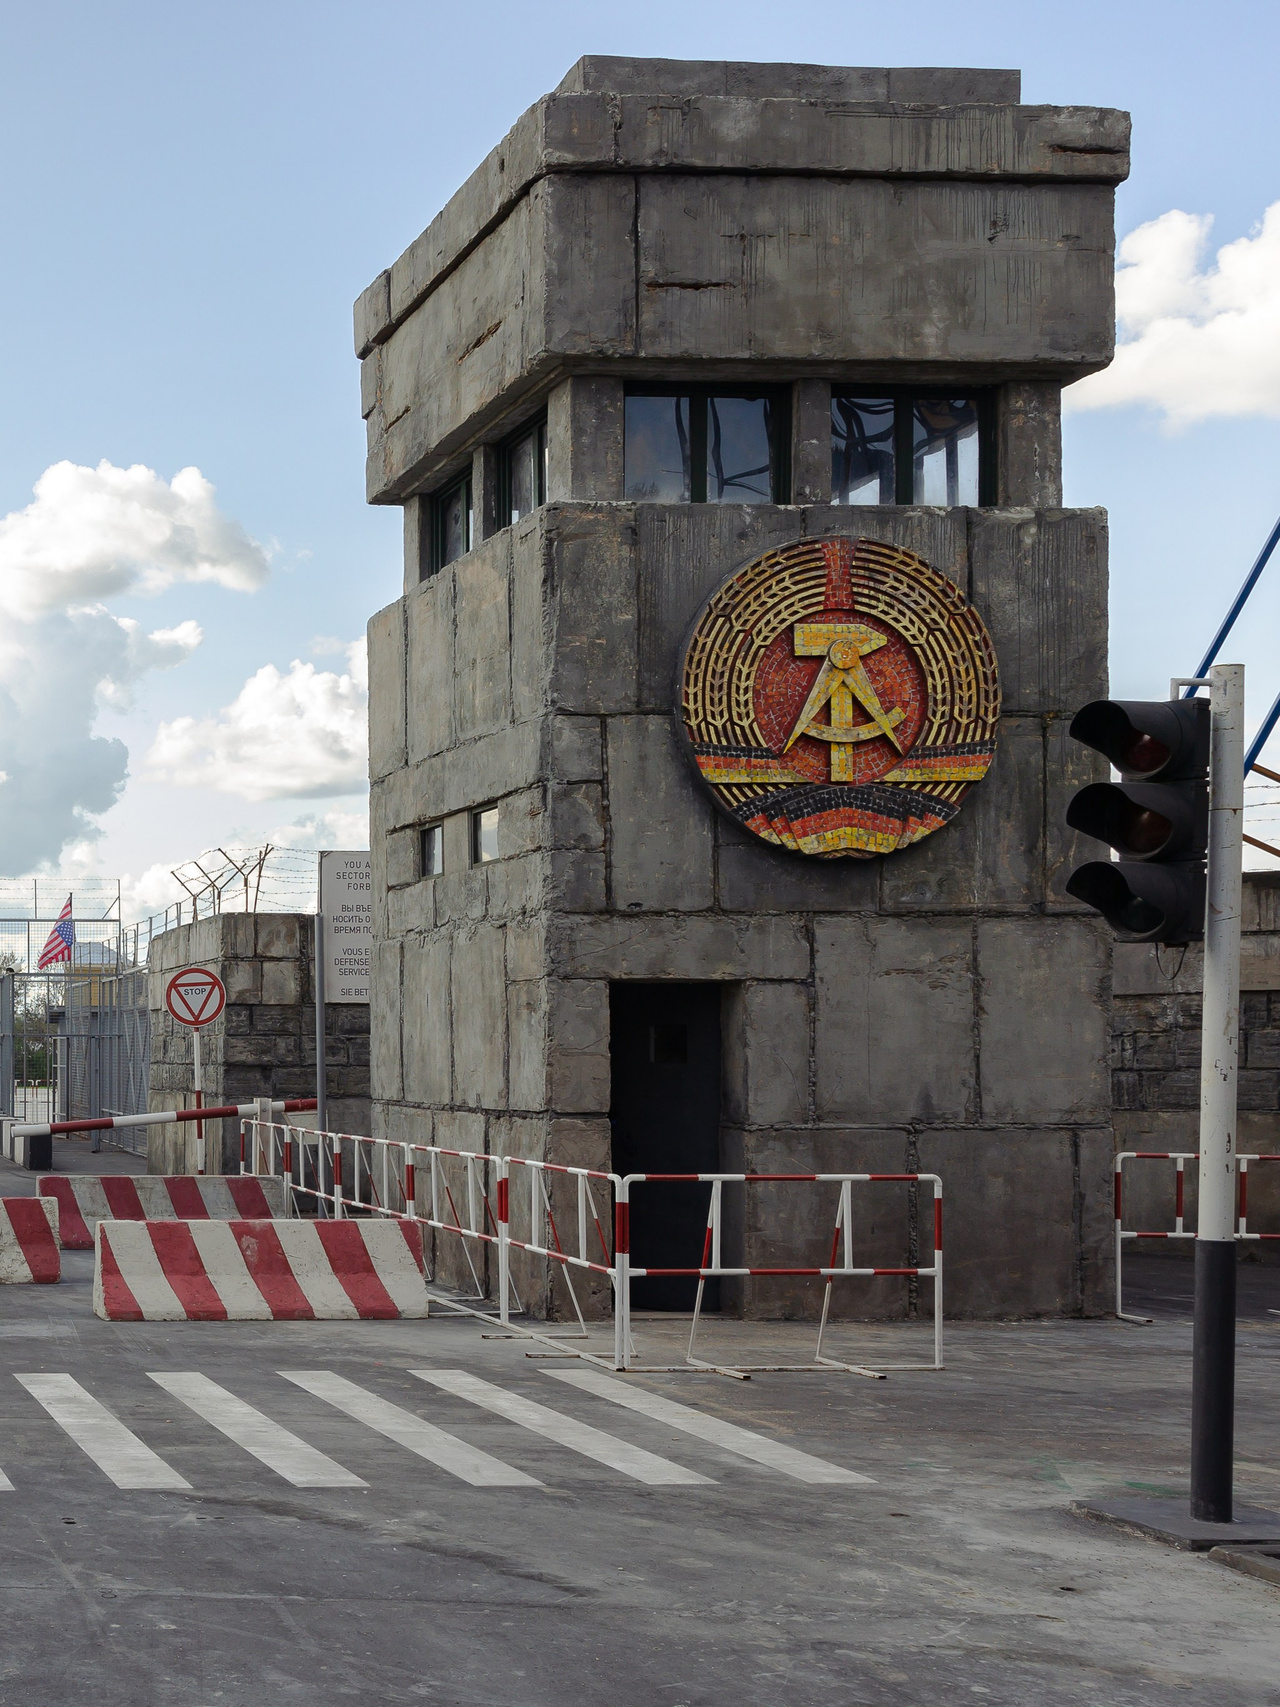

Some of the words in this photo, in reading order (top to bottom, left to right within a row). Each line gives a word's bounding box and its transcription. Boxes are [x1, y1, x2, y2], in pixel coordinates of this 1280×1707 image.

[344, 861, 361, 869] YOU
[336, 871, 371, 880] SECTOR
[341, 904, 354, 912] ВЫ
[332, 915, 364, 923] НОСИТЬ
[334, 926, 361, 934] ВРЕМЯ
[342, 948, 362, 956] VOUS
[334, 958, 370, 966] DEFENSE
[338, 968, 370, 976] SERVICE
[184, 988, 207, 996] STOP
[340, 988, 353, 996] SIE
